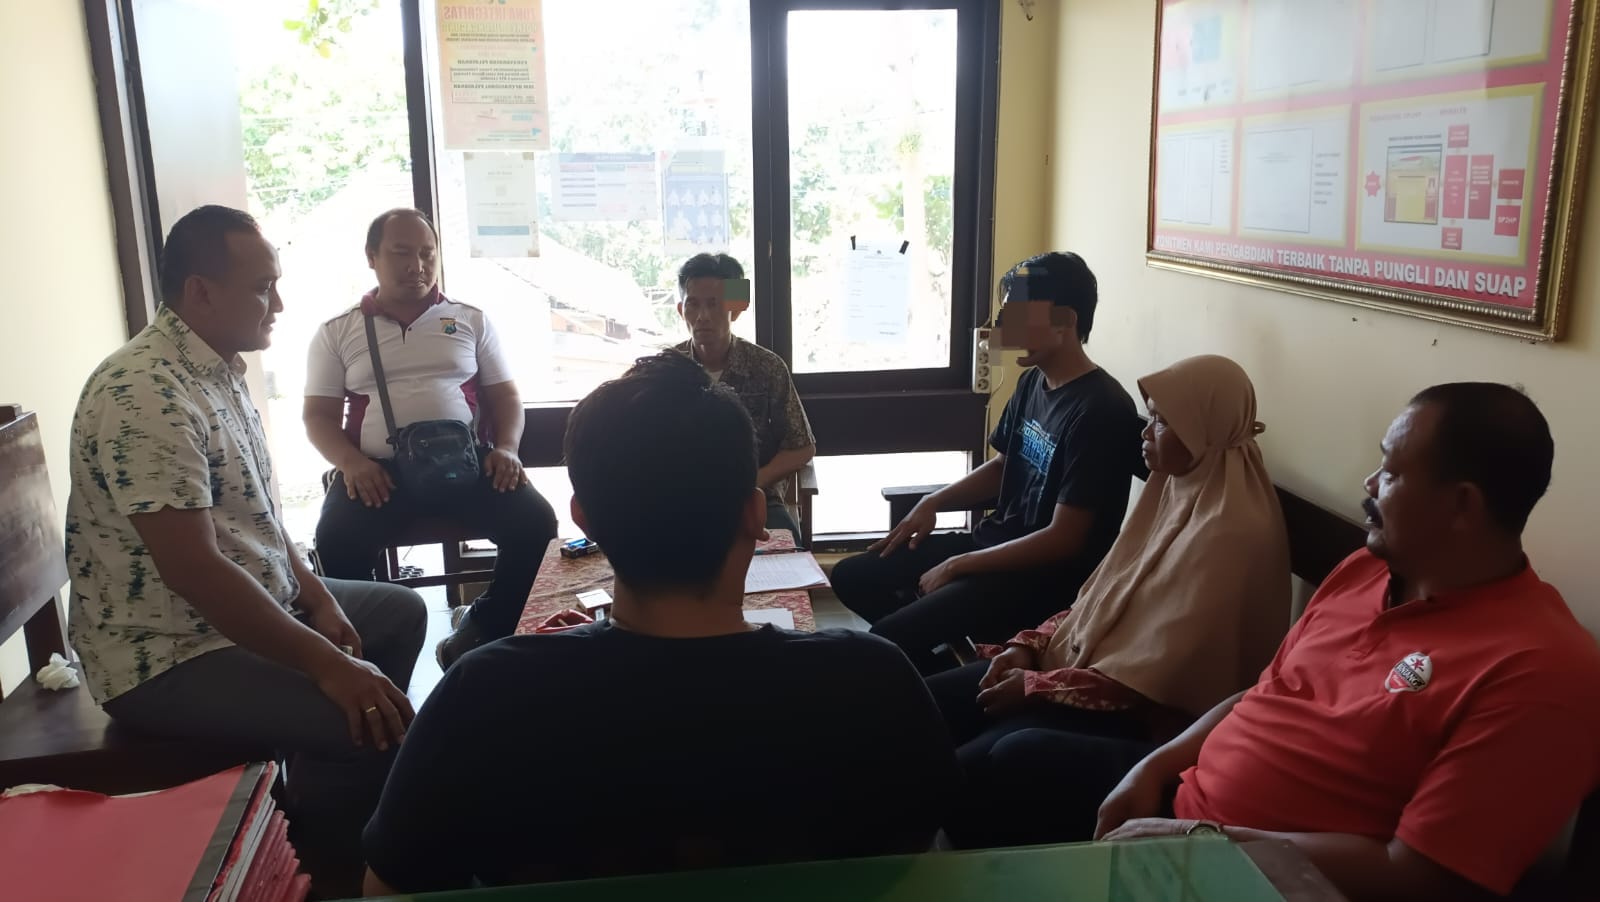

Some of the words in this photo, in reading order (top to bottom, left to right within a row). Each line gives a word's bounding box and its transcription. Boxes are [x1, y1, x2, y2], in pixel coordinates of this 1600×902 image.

[1193, 239, 1214, 255] KAMI
[1215, 242, 1274, 264] PENGABDIAN
[1277, 250, 1325, 270] TERBAIK
[1328, 255, 1370, 277] TANPA
[1374, 260, 1430, 285] PUNGLI
[1434, 267, 1469, 290] DAN
[1475, 272, 1527, 298] SUAP
